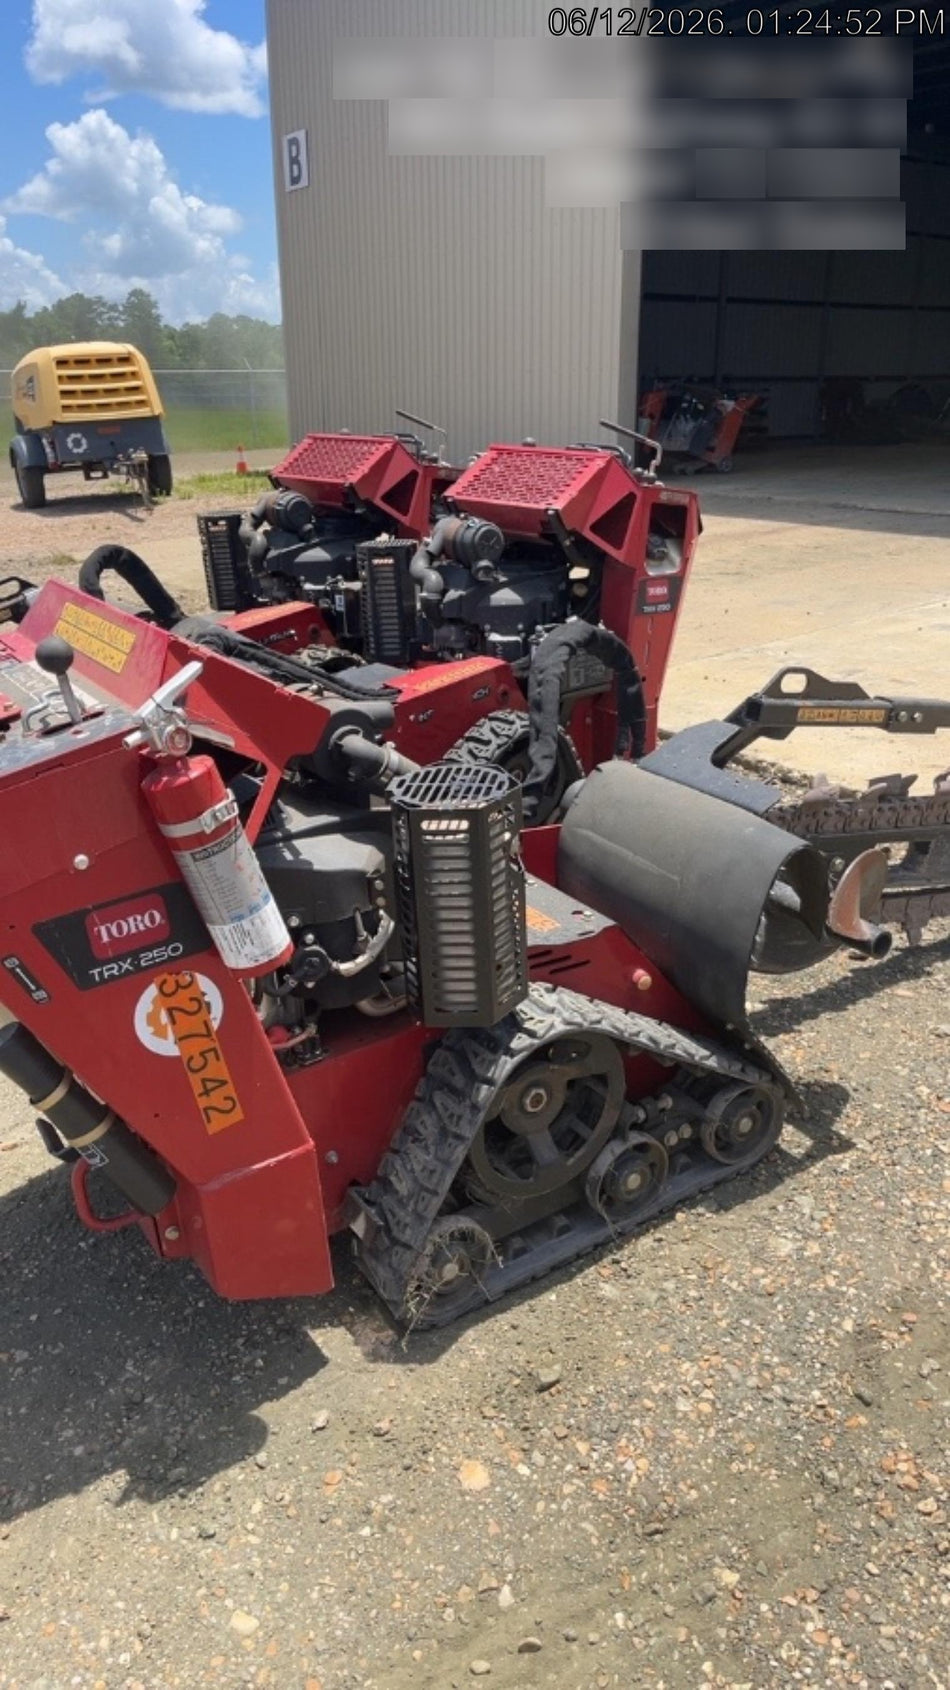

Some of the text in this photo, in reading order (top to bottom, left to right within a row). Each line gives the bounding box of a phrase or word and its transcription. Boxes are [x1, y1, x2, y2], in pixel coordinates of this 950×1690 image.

[287, 136, 302, 186] B
[94, 908, 162, 944] TORO
[159, 971, 236, 1124] 327542
